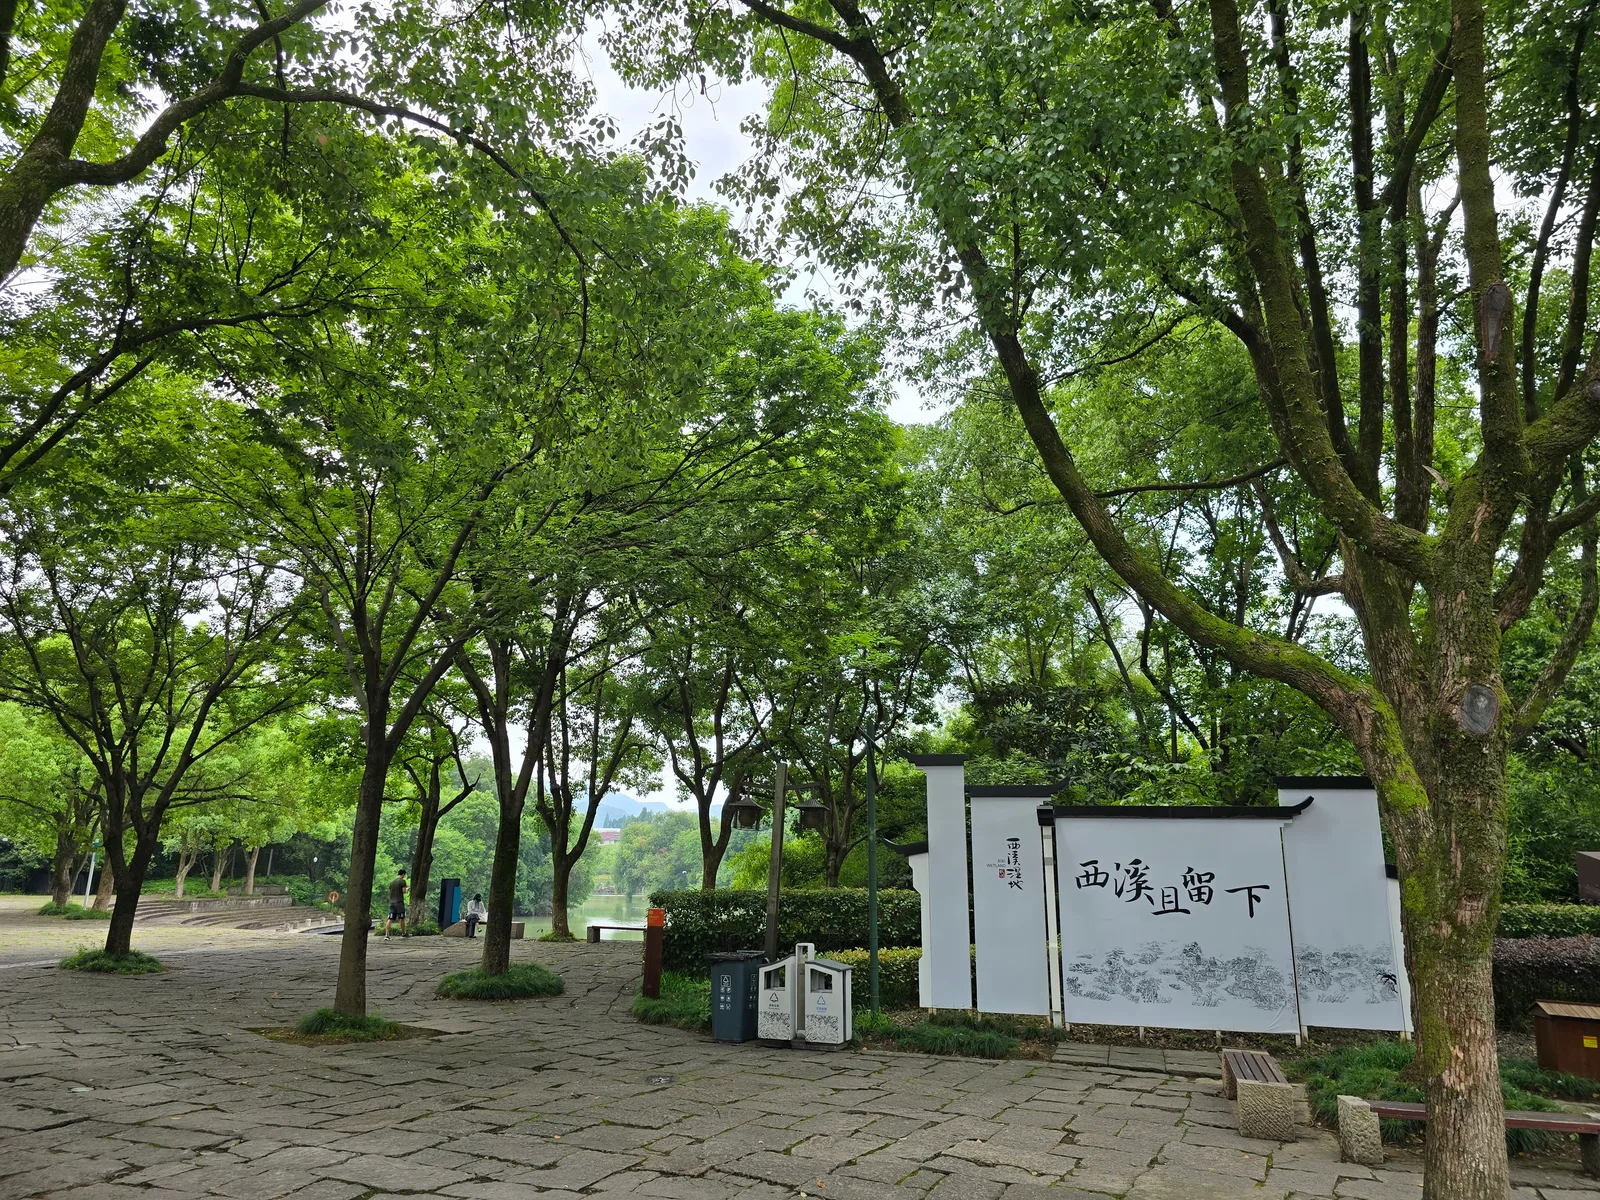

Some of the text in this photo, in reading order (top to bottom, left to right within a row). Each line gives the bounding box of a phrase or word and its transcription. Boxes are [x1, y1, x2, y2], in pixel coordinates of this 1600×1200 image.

[1075, 858, 1270, 918] 西溪且留下
